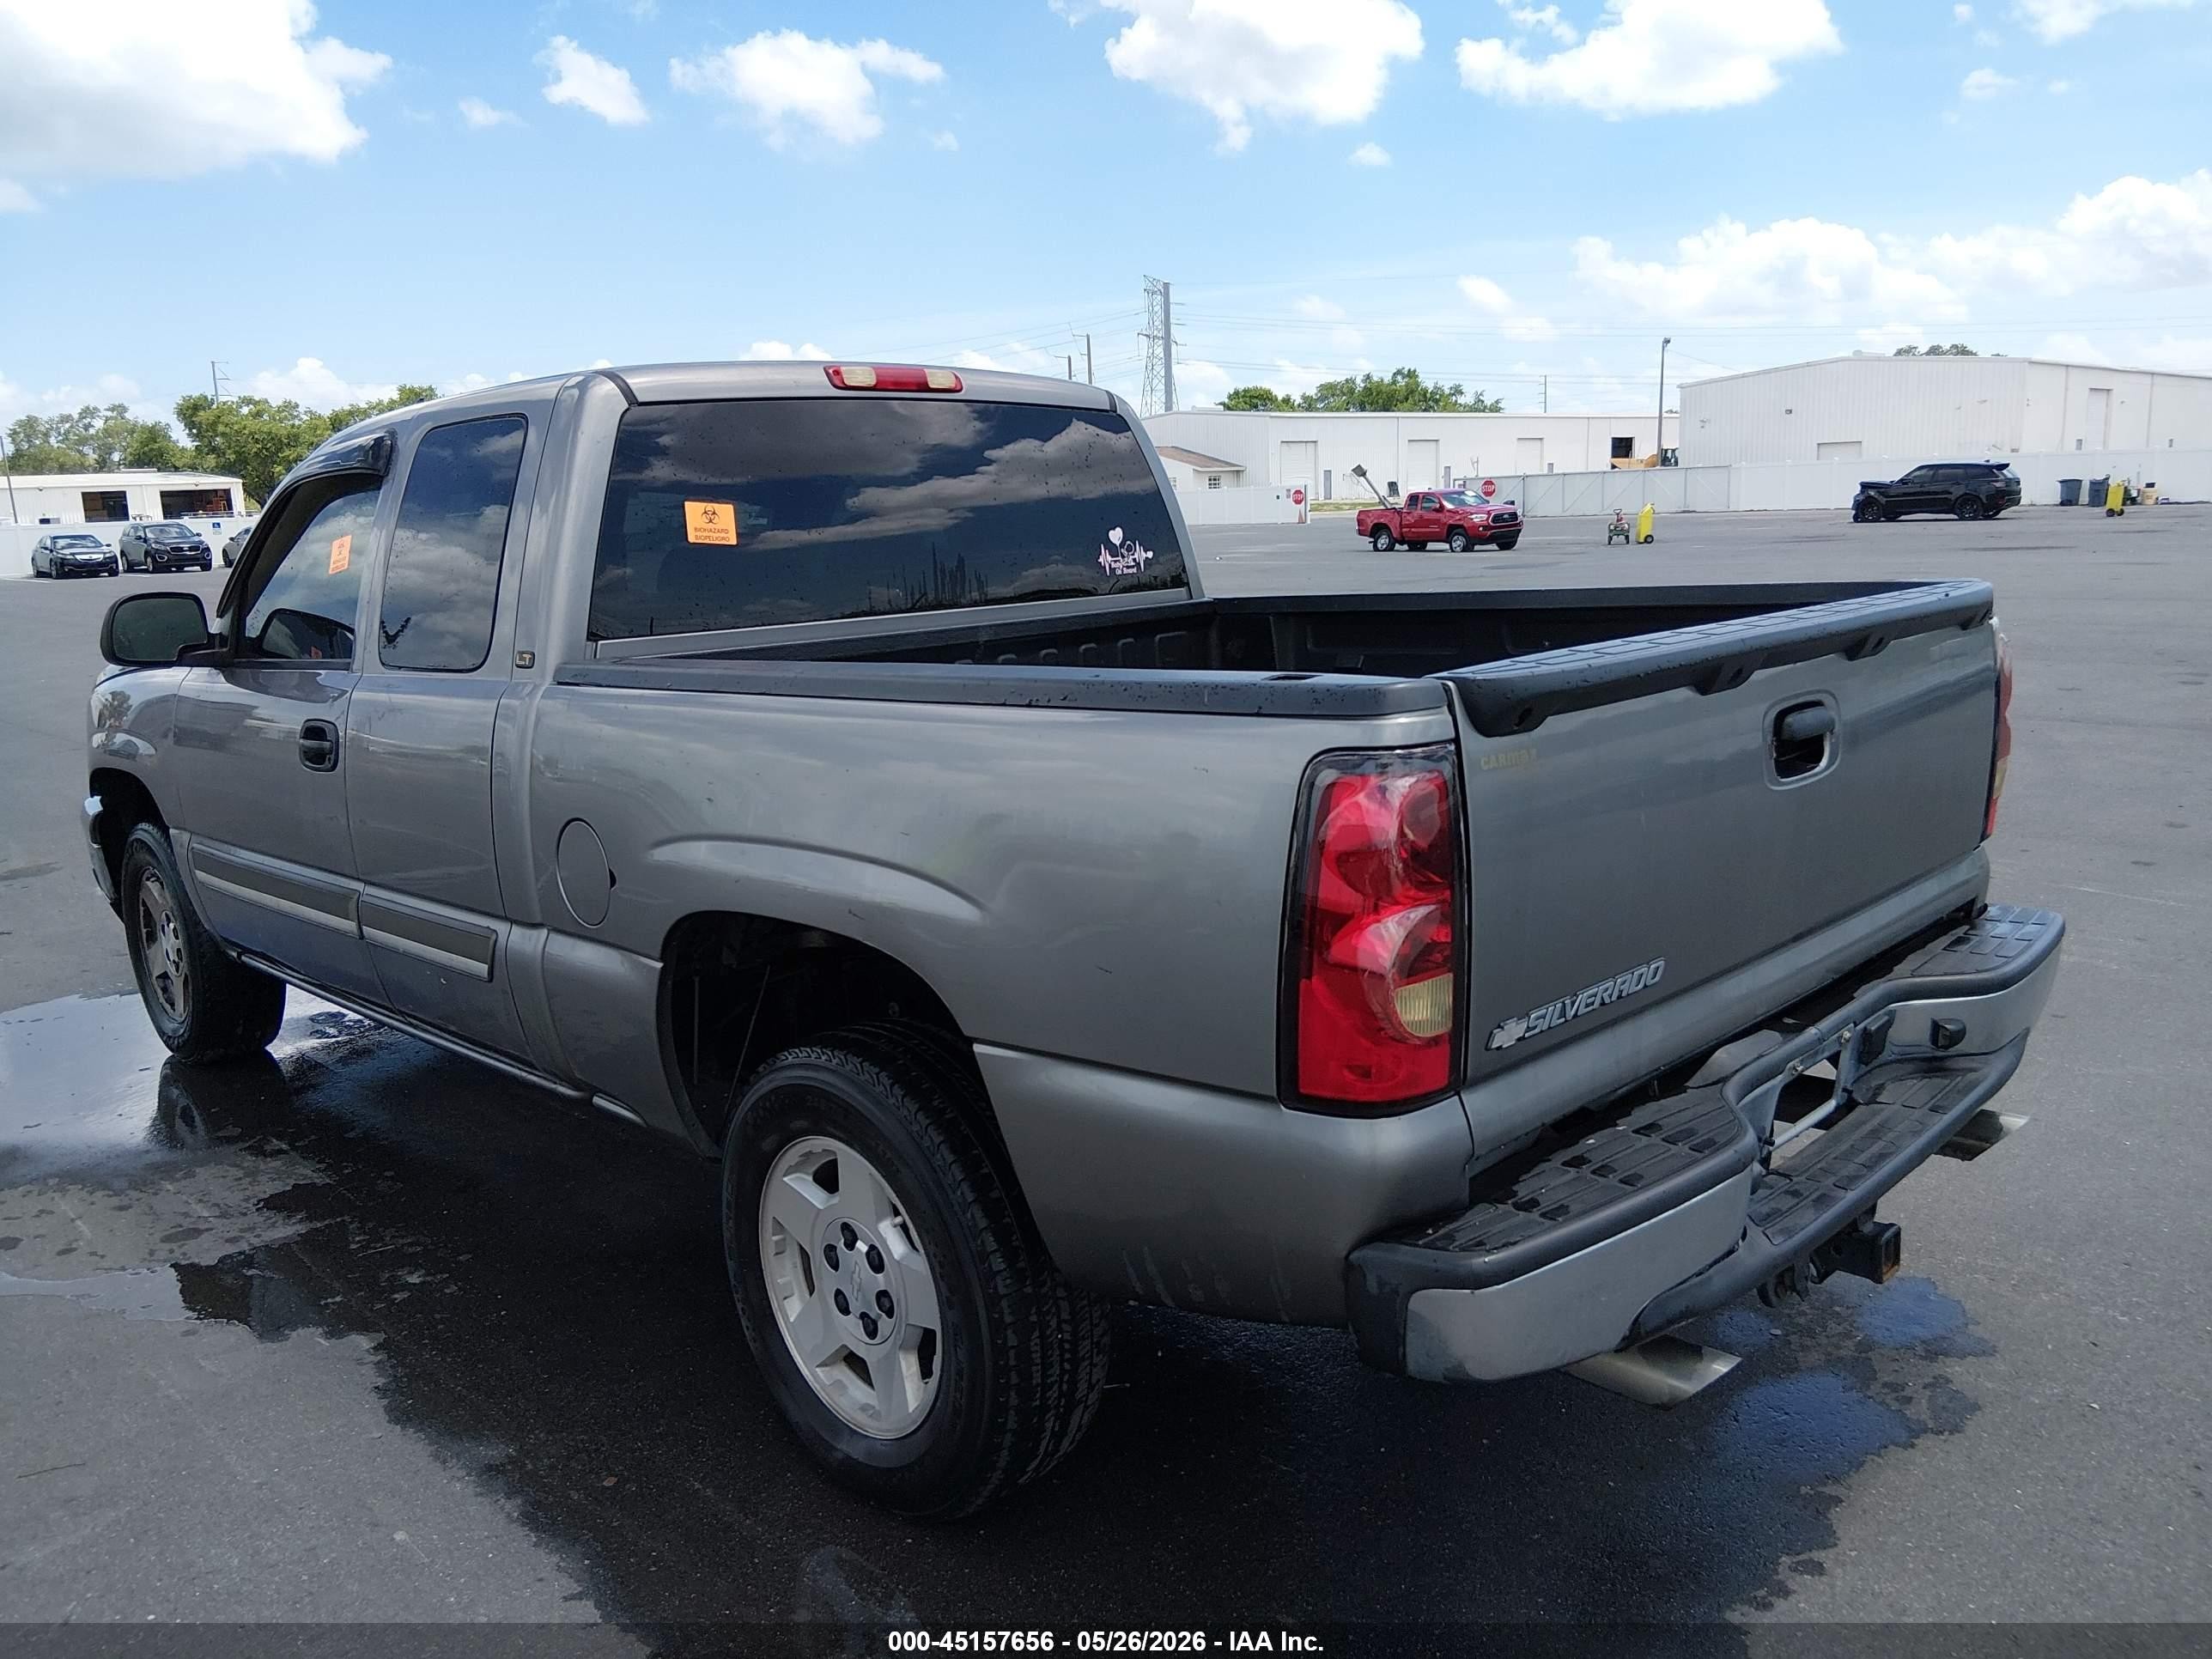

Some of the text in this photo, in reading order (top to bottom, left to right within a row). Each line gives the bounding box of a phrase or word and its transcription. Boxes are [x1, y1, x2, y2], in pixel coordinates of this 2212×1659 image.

[1482, 484, 1495, 493] STOP
[516, 653, 532, 665] LT
[1524, 958, 1666, 1038] SILVERADO
